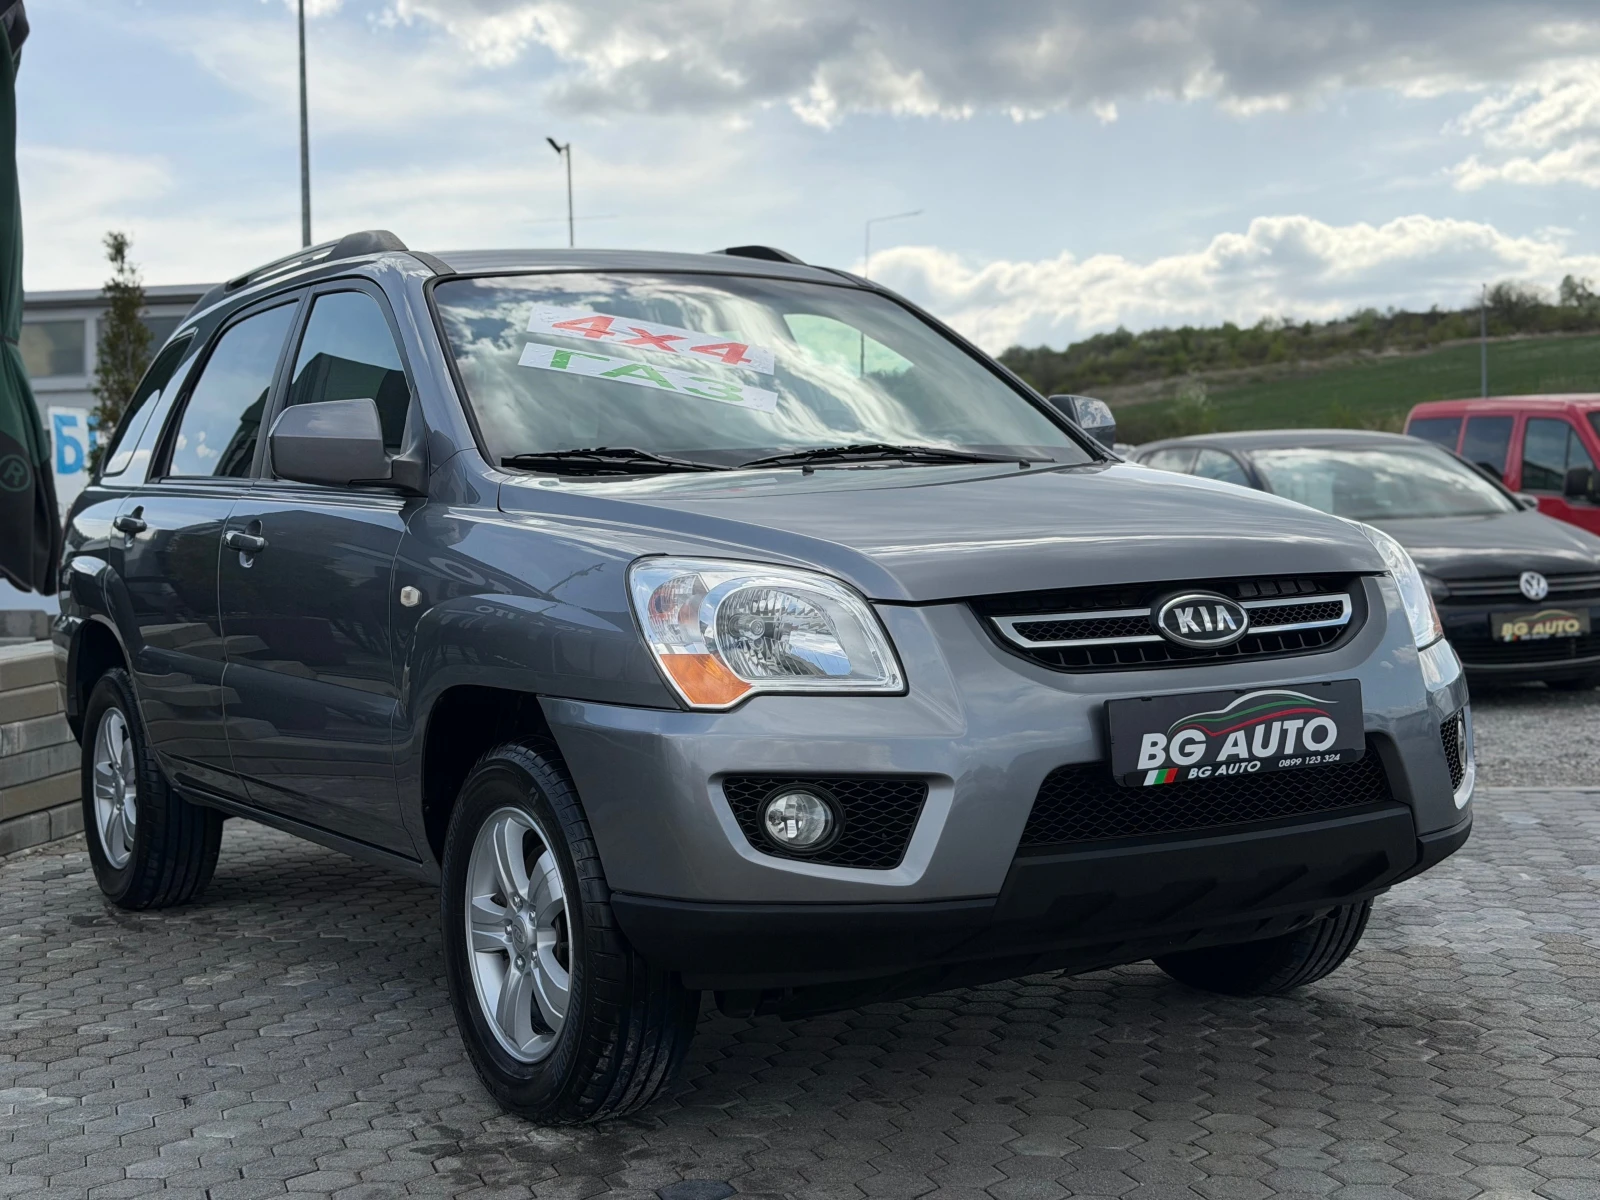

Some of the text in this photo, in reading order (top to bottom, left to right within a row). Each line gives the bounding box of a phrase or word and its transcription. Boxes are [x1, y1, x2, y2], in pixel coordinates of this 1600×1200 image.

[550, 350, 744, 402] ГАЗ
[1173, 605, 1237, 634] KIA
[1532, 619, 1580, 635] AUTO
[1137, 716, 1338, 770] BG AUTO
[1188, 760, 1261, 779] BG AUTO
[1278, 753, 1341, 768] 0899 123 324
